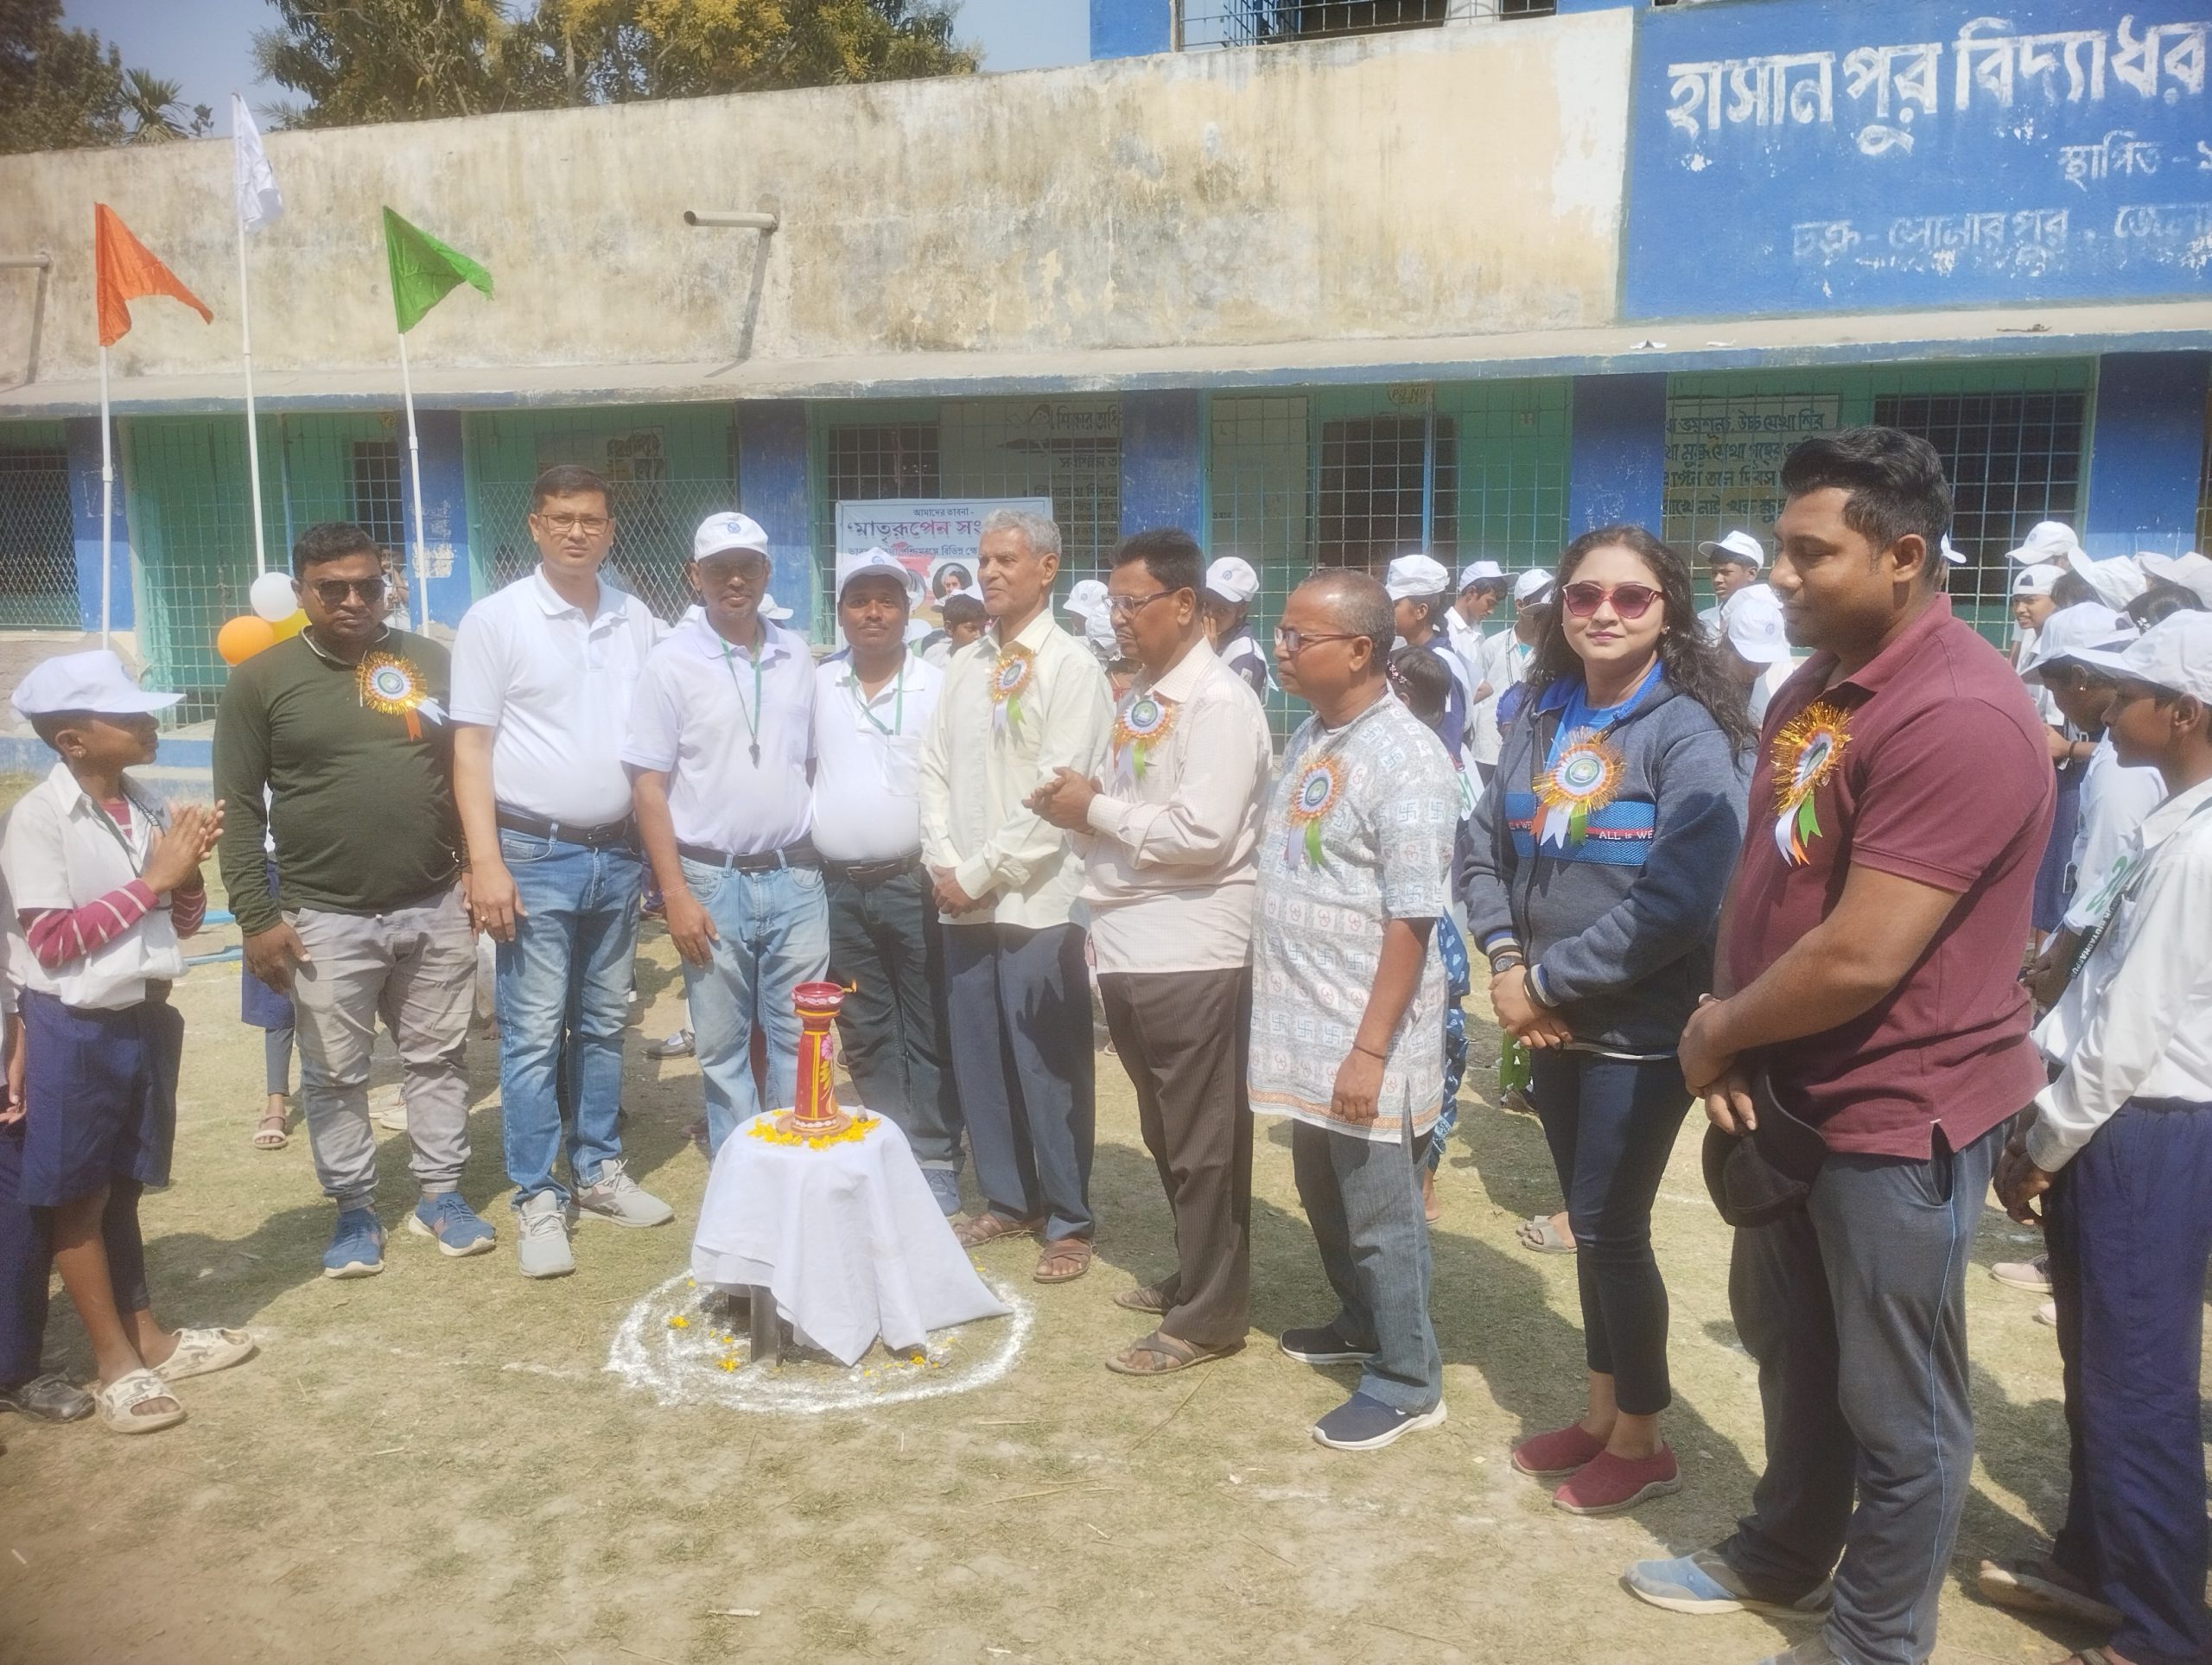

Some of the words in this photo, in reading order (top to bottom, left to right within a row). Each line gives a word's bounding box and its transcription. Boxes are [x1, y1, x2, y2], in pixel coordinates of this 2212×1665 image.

[956, 520, 982, 535] সং
[1599, 830, 1621, 841] ALL
[1637, 829, 1653, 840] WE
